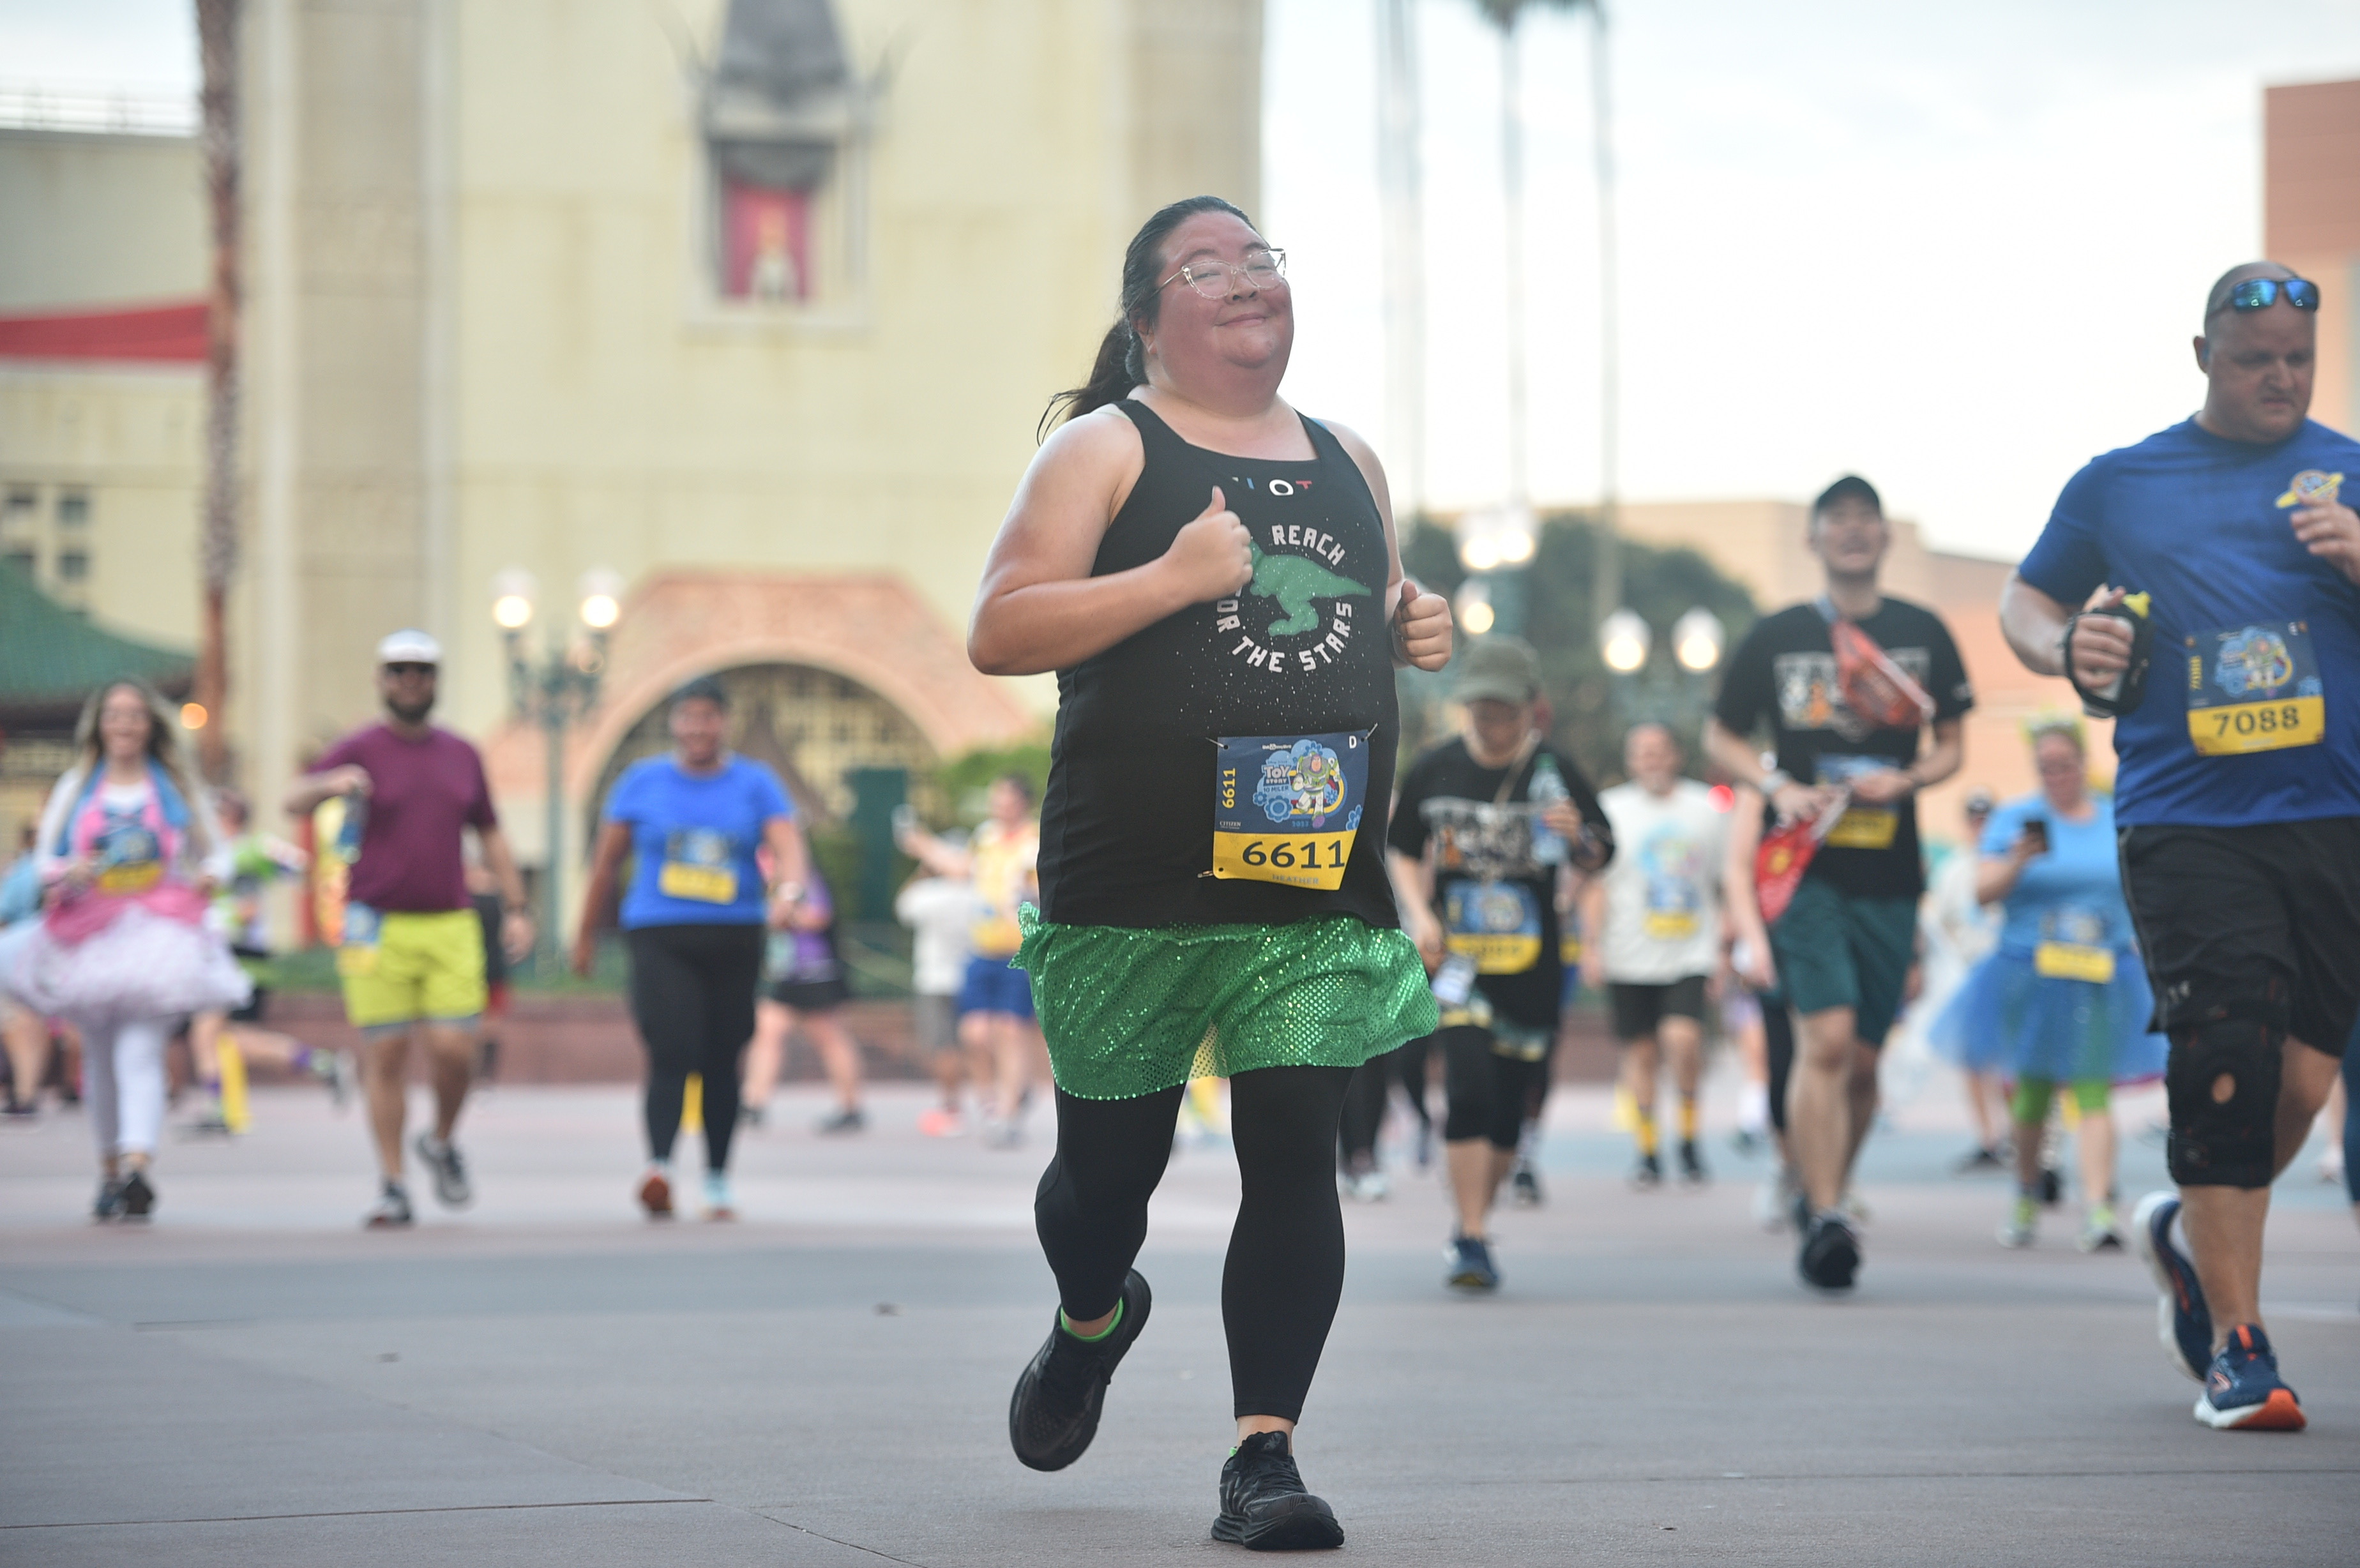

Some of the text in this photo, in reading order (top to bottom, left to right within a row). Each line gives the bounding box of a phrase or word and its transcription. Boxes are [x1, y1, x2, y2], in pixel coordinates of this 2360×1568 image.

[1271, 525, 1345, 566] REACH
[1216, 585, 1352, 673] OR THE STARS
[2211, 704, 2300, 736] 7088
[1349, 735, 1357, 749] D
[1222, 767, 1236, 809] 6611
[1264, 765, 1290, 779] TOY
[1242, 840, 1345, 870] 6611
